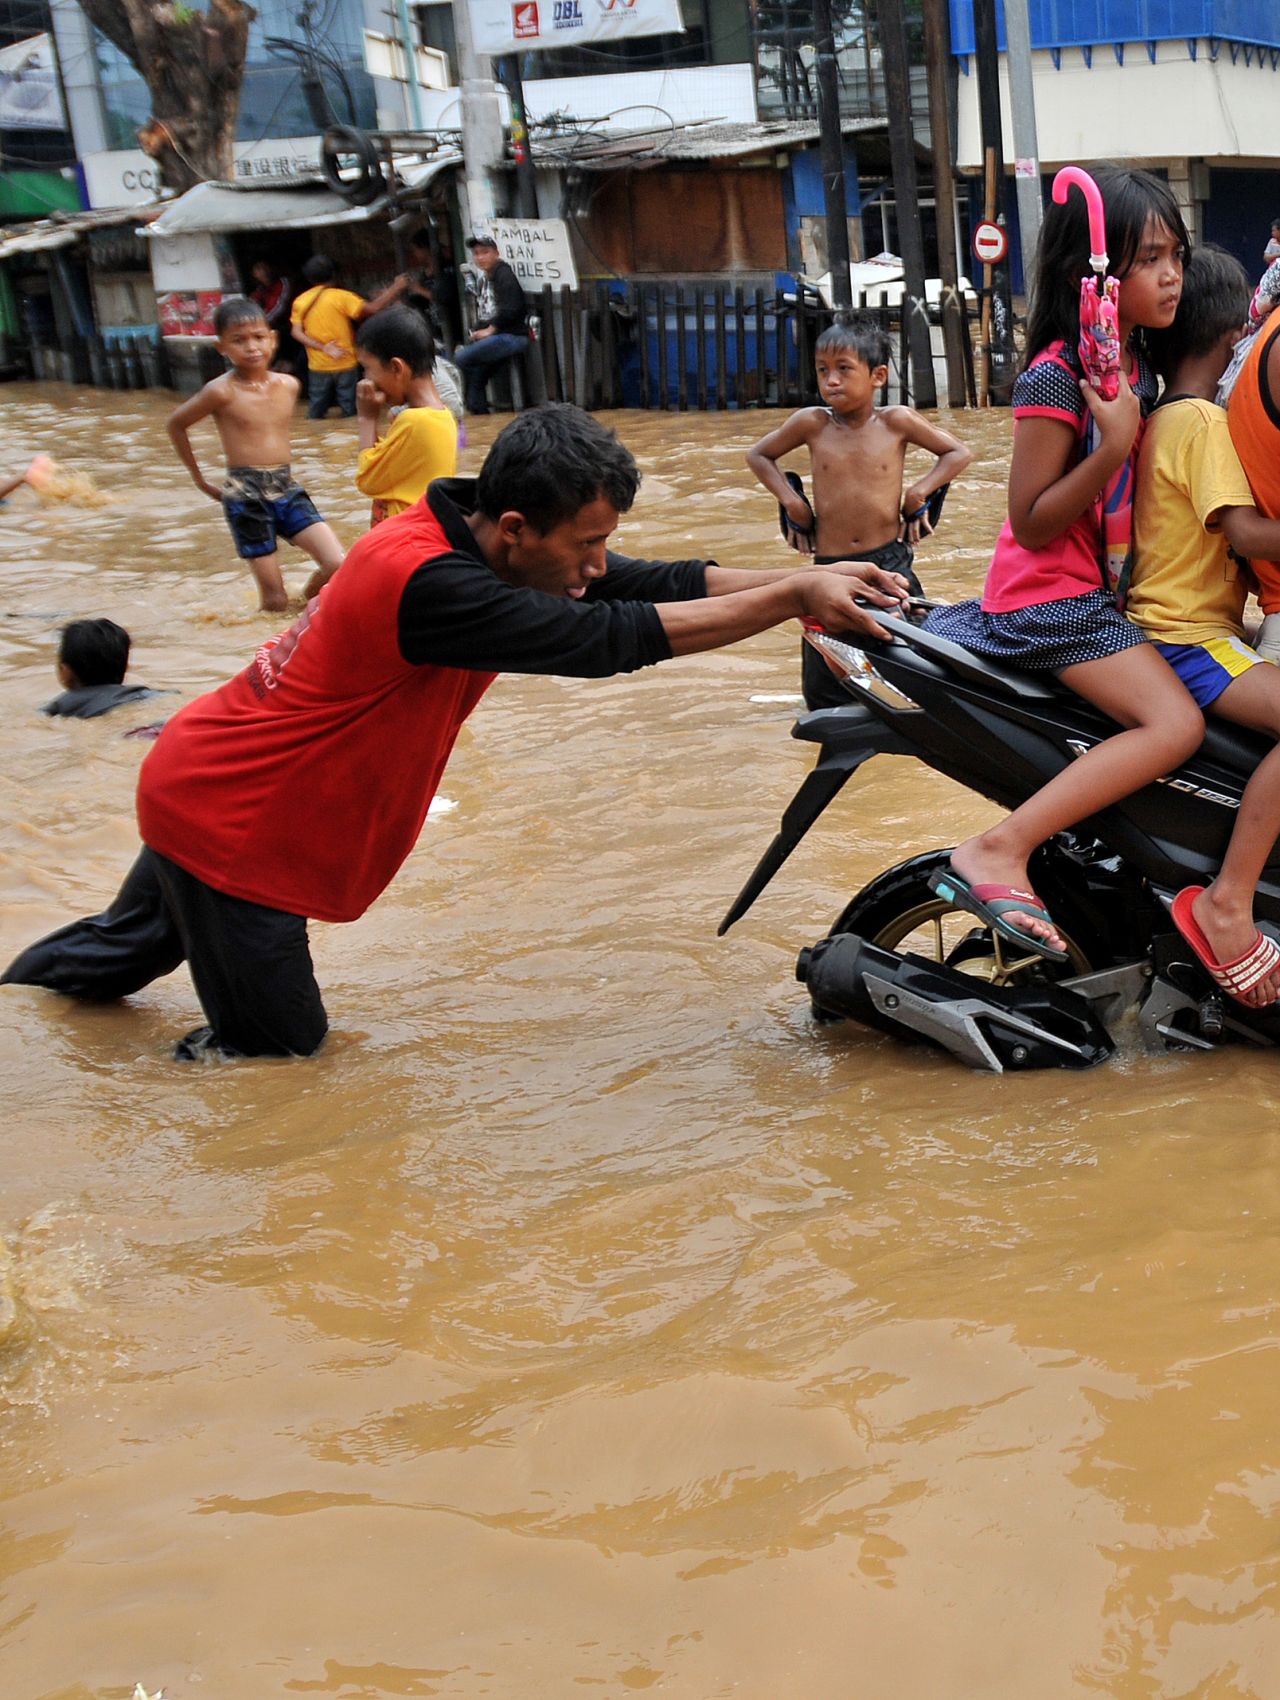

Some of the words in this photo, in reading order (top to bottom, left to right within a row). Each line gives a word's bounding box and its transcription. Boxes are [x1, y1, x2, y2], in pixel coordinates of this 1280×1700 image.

[553, 0, 583, 20] DBL
[122, 168, 159, 191] CC
[492, 228, 555, 243] TAMBAL
[506, 244, 535, 259] BAN
